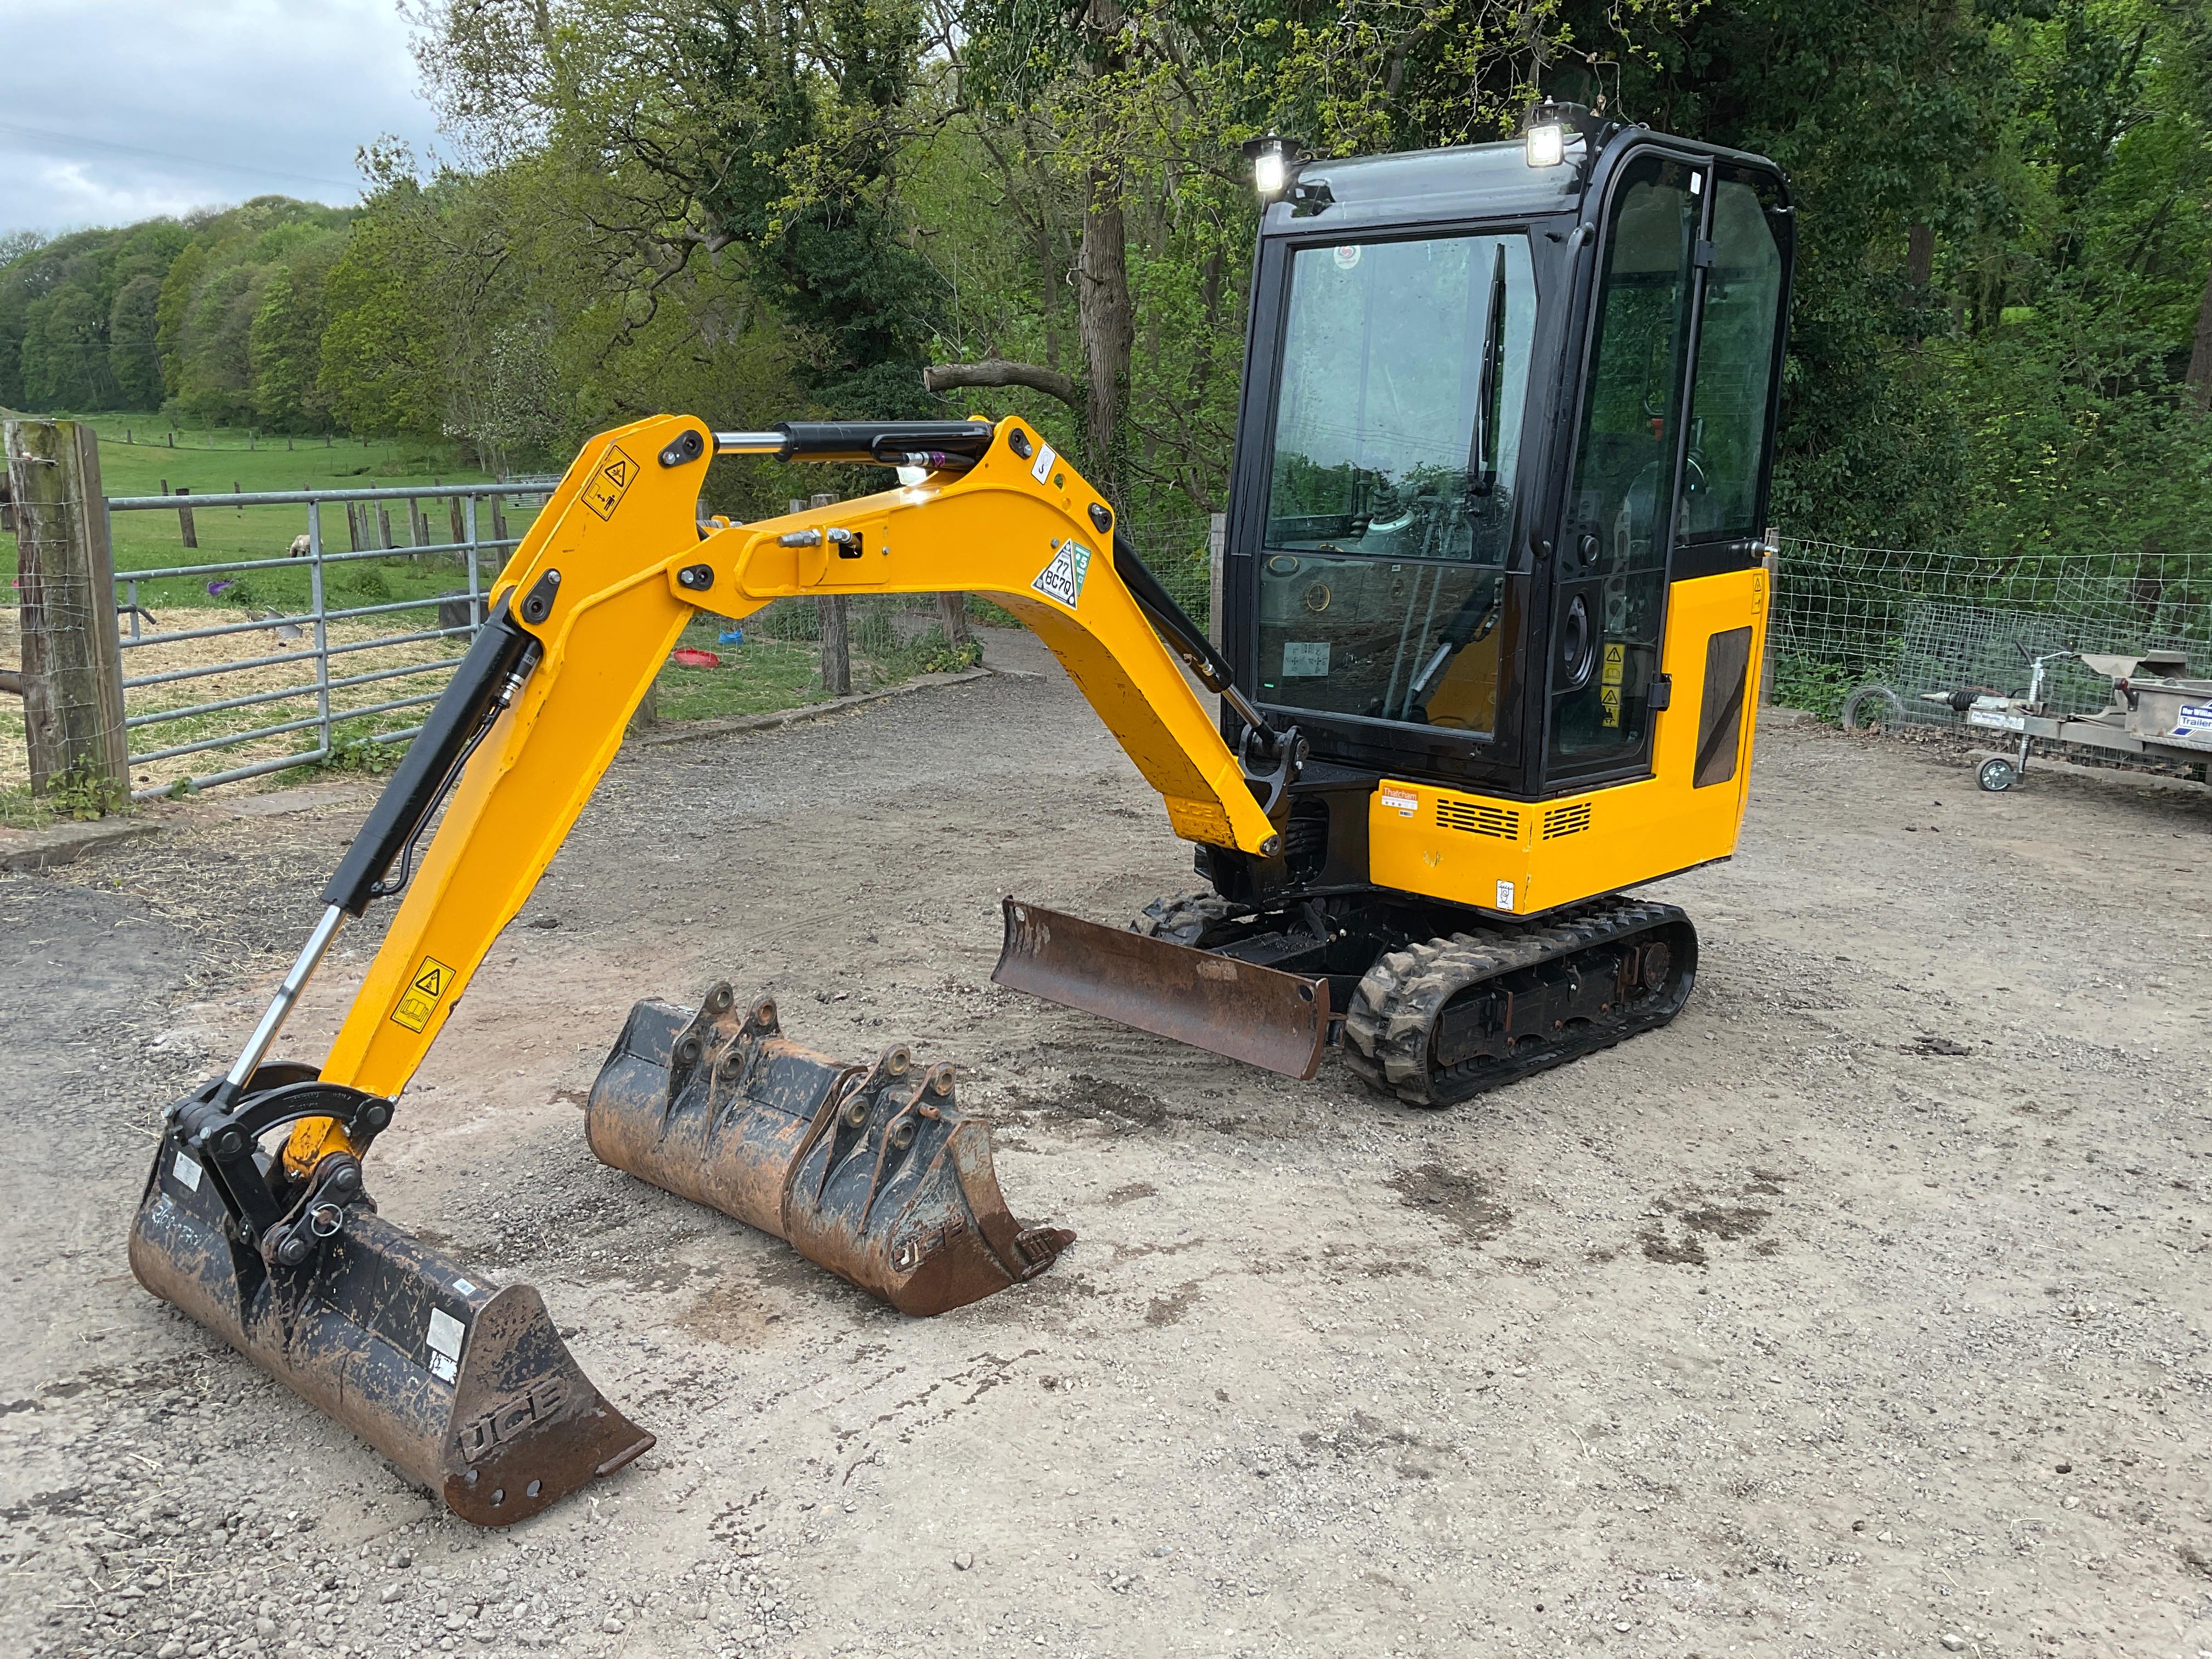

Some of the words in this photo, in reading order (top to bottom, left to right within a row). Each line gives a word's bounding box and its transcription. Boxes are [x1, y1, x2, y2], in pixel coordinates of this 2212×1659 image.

[1057, 558, 1069, 576] 77
[1080, 556, 1088, 568] 5
[1045, 570, 1071, 595] BC7Q
[1384, 787, 1417, 800] Thatcham
[894, 1215, 967, 1272] JCB
[460, 1377, 568, 1463] JCB
